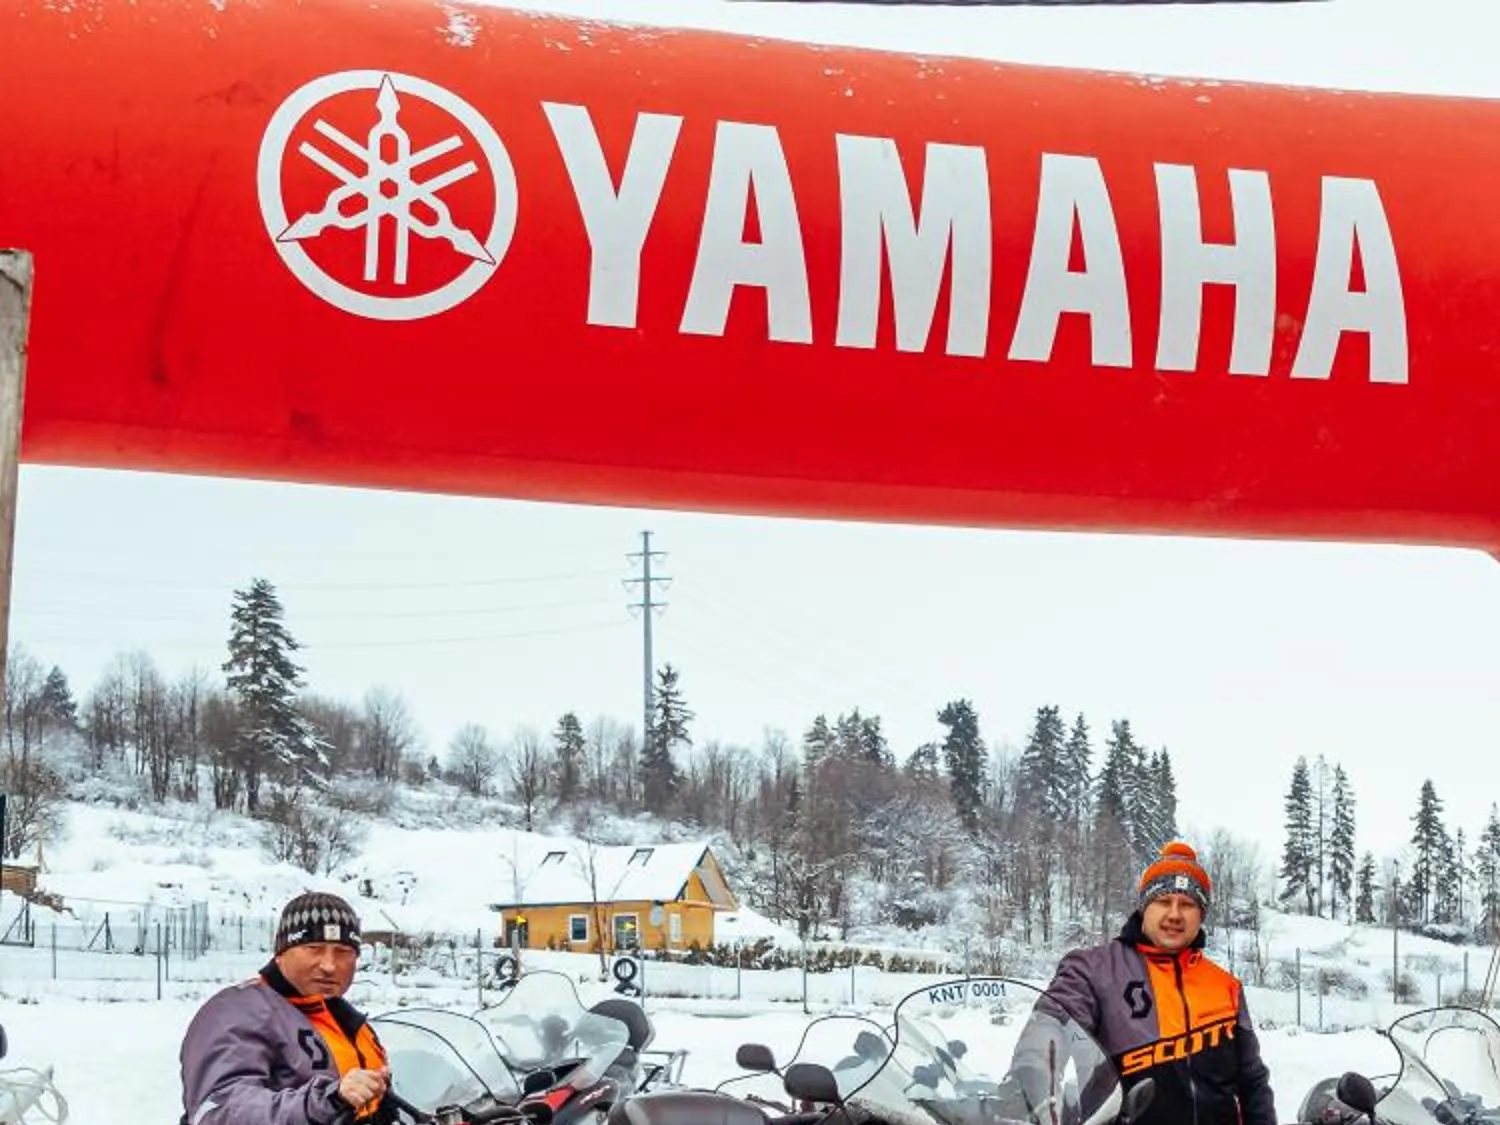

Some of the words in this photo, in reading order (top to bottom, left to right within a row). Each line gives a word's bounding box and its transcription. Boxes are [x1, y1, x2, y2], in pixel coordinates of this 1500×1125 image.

[541, 101, 1409, 384] YAMAHA
[929, 985, 963, 1005] KNT
[972, 982, 1006, 997] 0001
[1122, 1020, 1237, 1076] SCOTT
